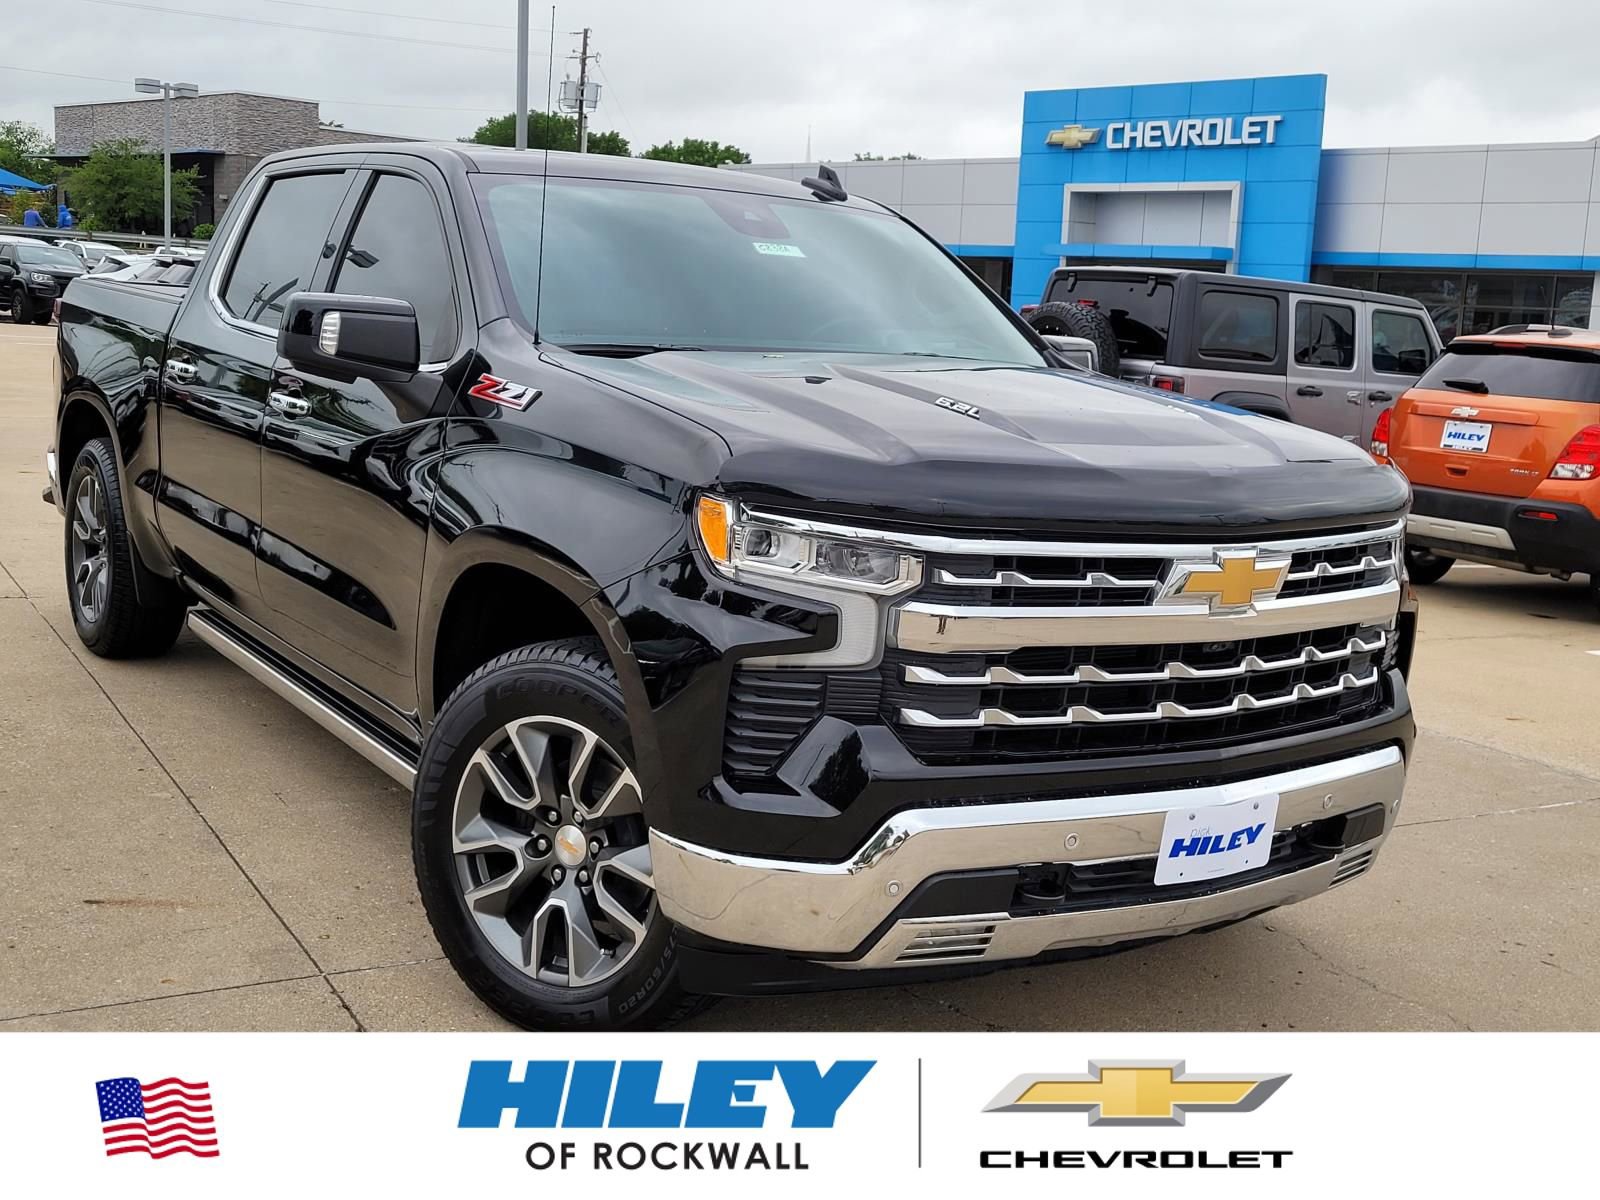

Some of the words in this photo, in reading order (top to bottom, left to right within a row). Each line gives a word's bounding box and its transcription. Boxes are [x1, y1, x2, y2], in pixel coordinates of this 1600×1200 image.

[1106, 115, 1282, 149] CHEVROLET
[468, 372, 542, 412] Z71
[1447, 431, 1486, 442] HILEY
[1168, 823, 1267, 859] HILEY
